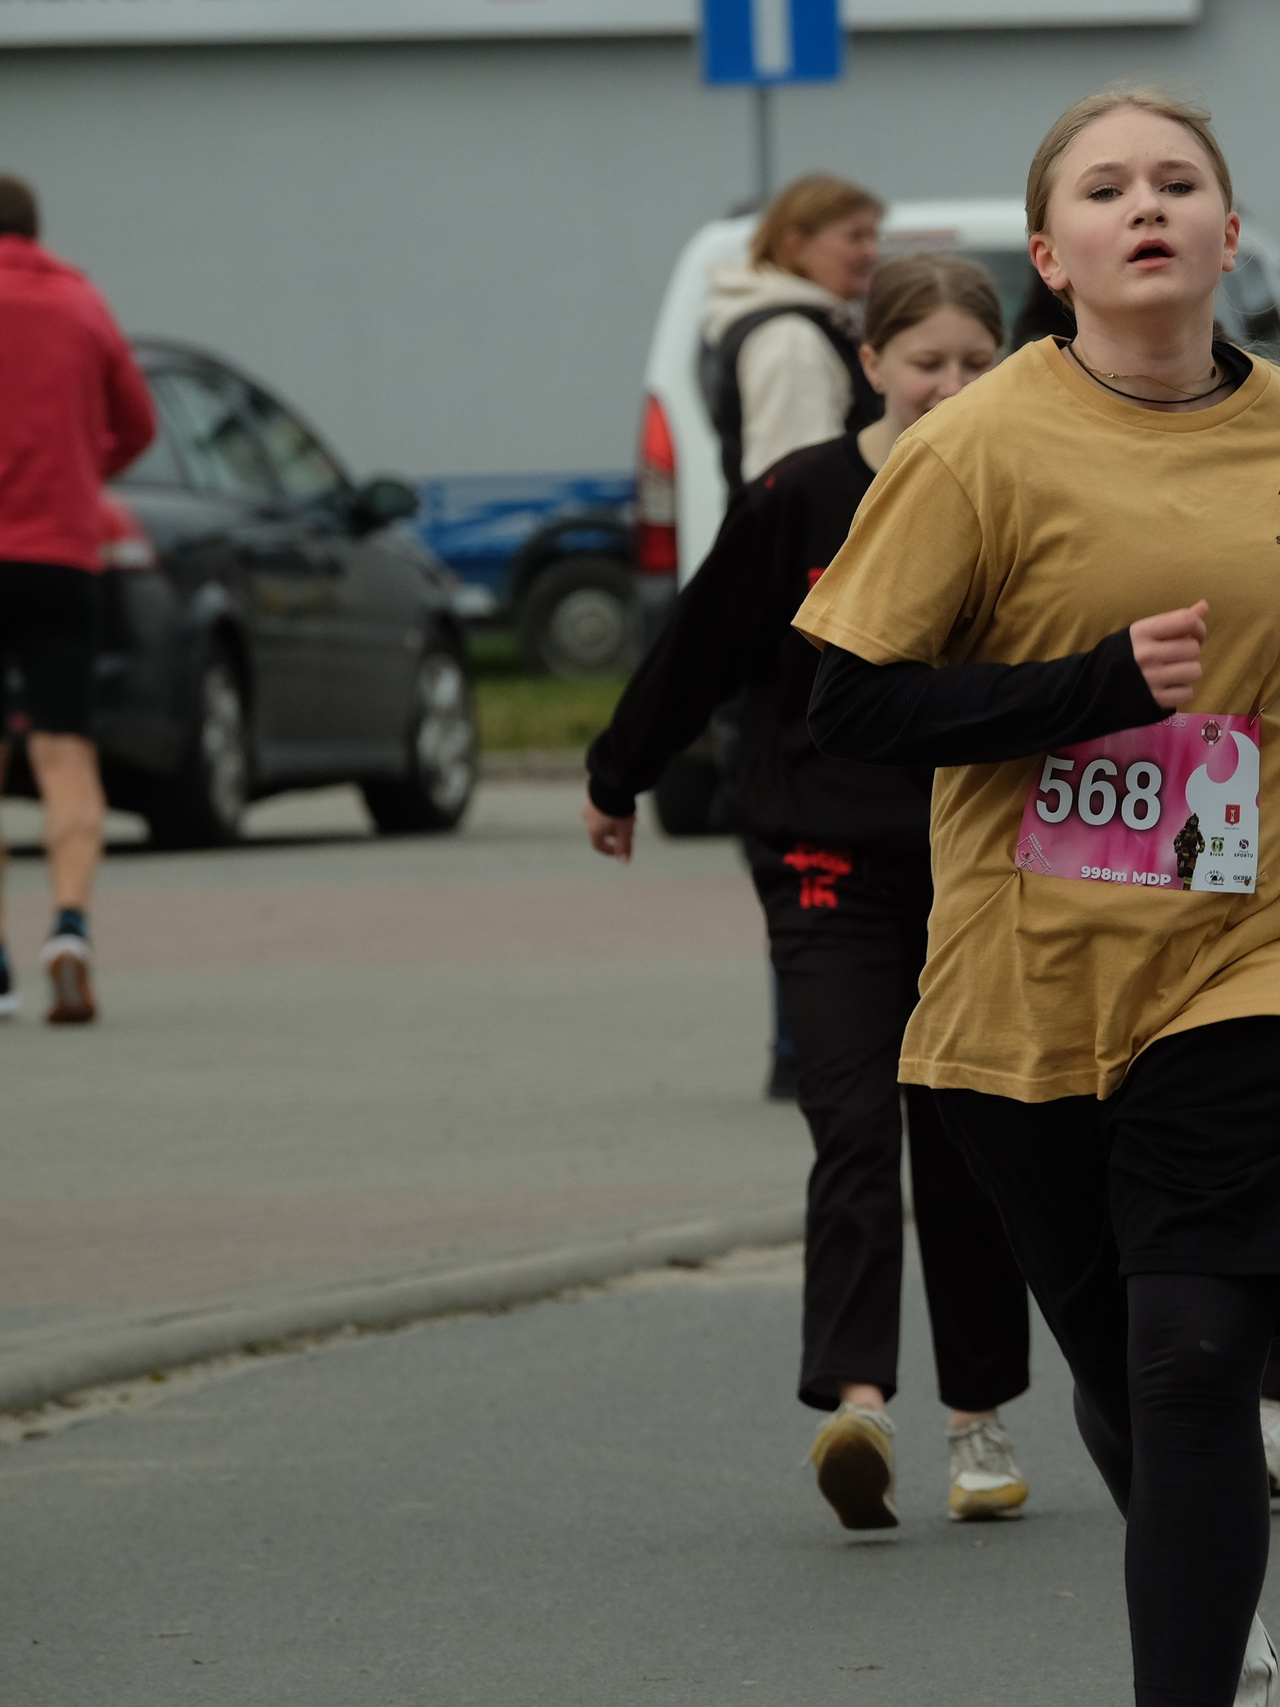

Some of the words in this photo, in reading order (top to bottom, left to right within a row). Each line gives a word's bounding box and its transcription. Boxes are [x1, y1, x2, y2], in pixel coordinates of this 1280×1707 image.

[1155, 716, 1188, 728] 025
[1036, 754, 1163, 831] 568
[1080, 865, 1128, 883] 998m
[1131, 870, 1171, 886] MDP
